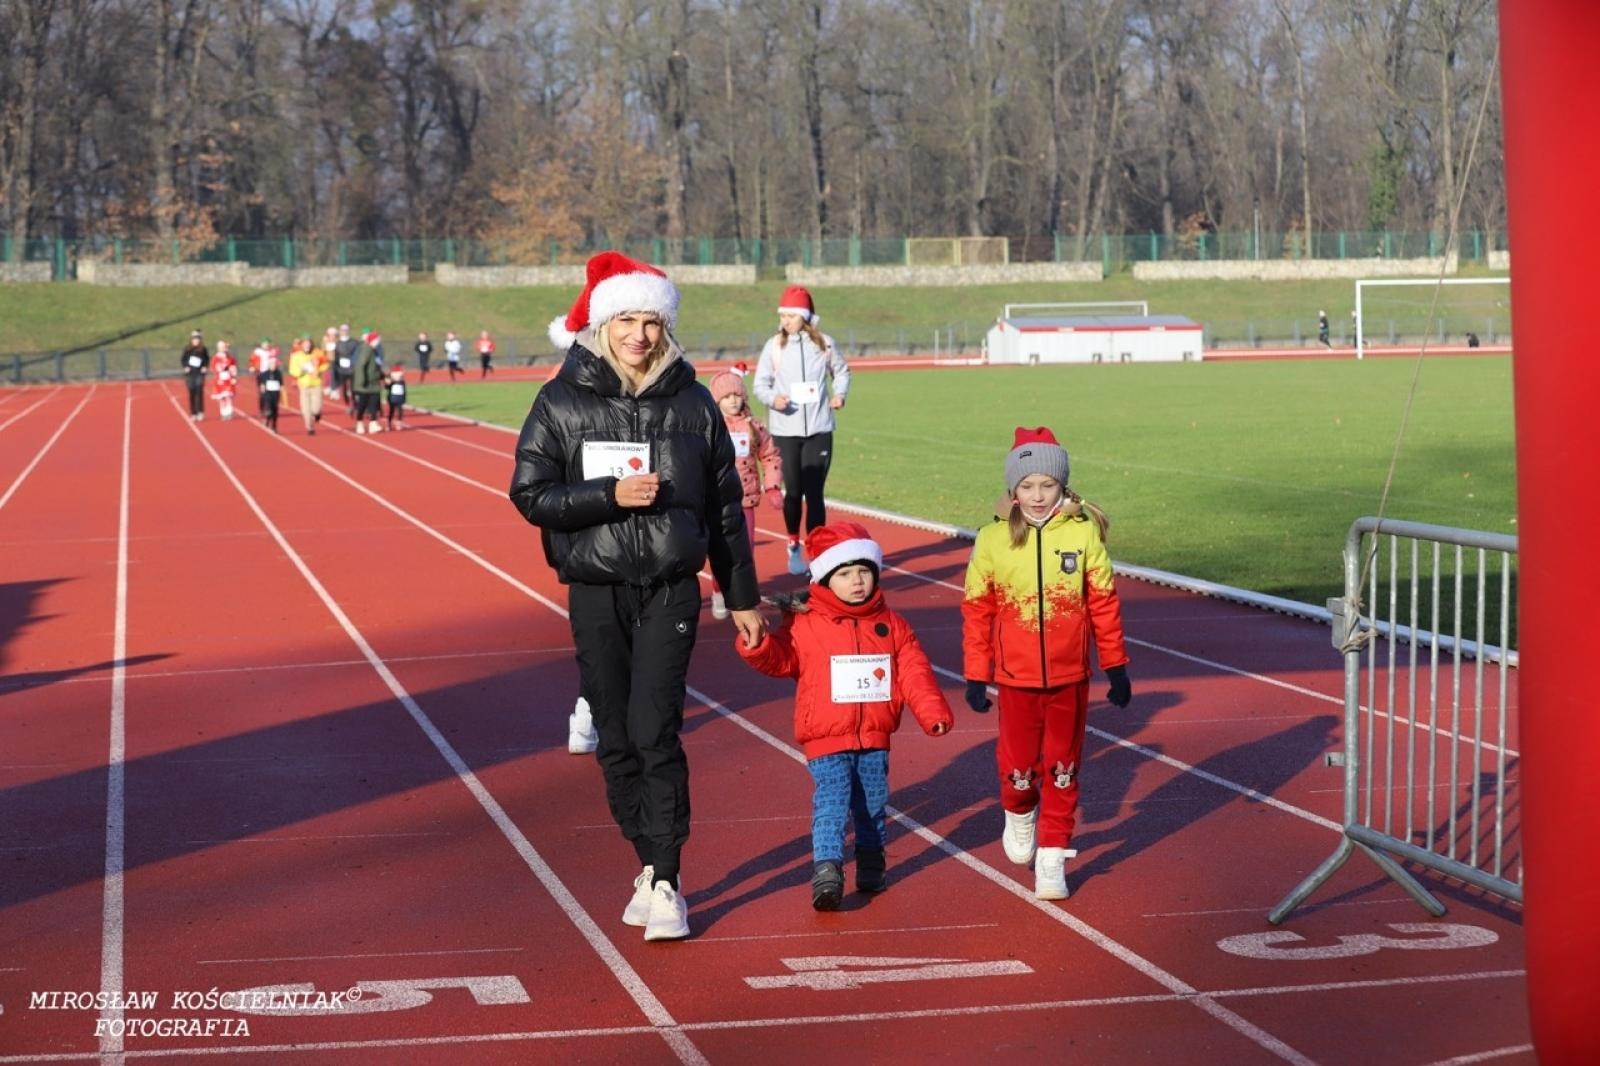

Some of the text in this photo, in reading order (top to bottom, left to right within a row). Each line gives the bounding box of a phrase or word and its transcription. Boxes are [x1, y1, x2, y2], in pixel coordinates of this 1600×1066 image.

[609, 466, 624, 478] 13
[857, 677, 871, 690] 15
[1216, 923, 1499, 961] 3
[742, 956, 1035, 991] 4
